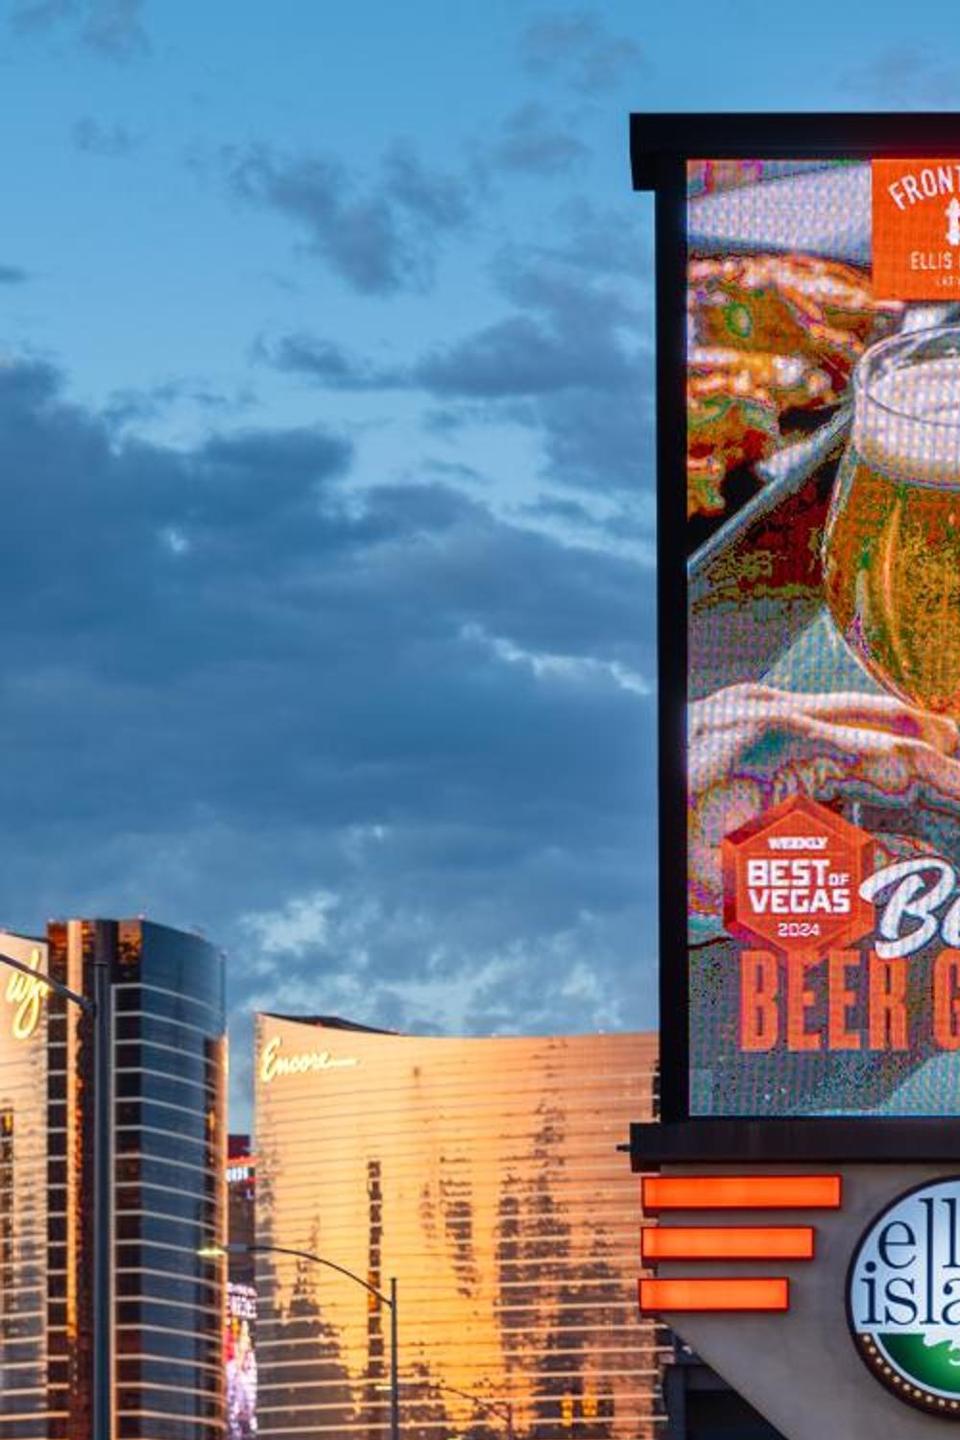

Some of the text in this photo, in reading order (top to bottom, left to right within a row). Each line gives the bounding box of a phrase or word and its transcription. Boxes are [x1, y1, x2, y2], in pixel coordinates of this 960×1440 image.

[910, 251, 953, 270] ELLIS
[767, 836, 828, 850] WEEKLY
[747, 859, 850, 887] BEST OF
[747, 888, 851, 914] VEGAS
[777, 923, 820, 937] 2024
[740, 948, 908, 1052] BEER
[260, 1036, 360, 1082] Encore
